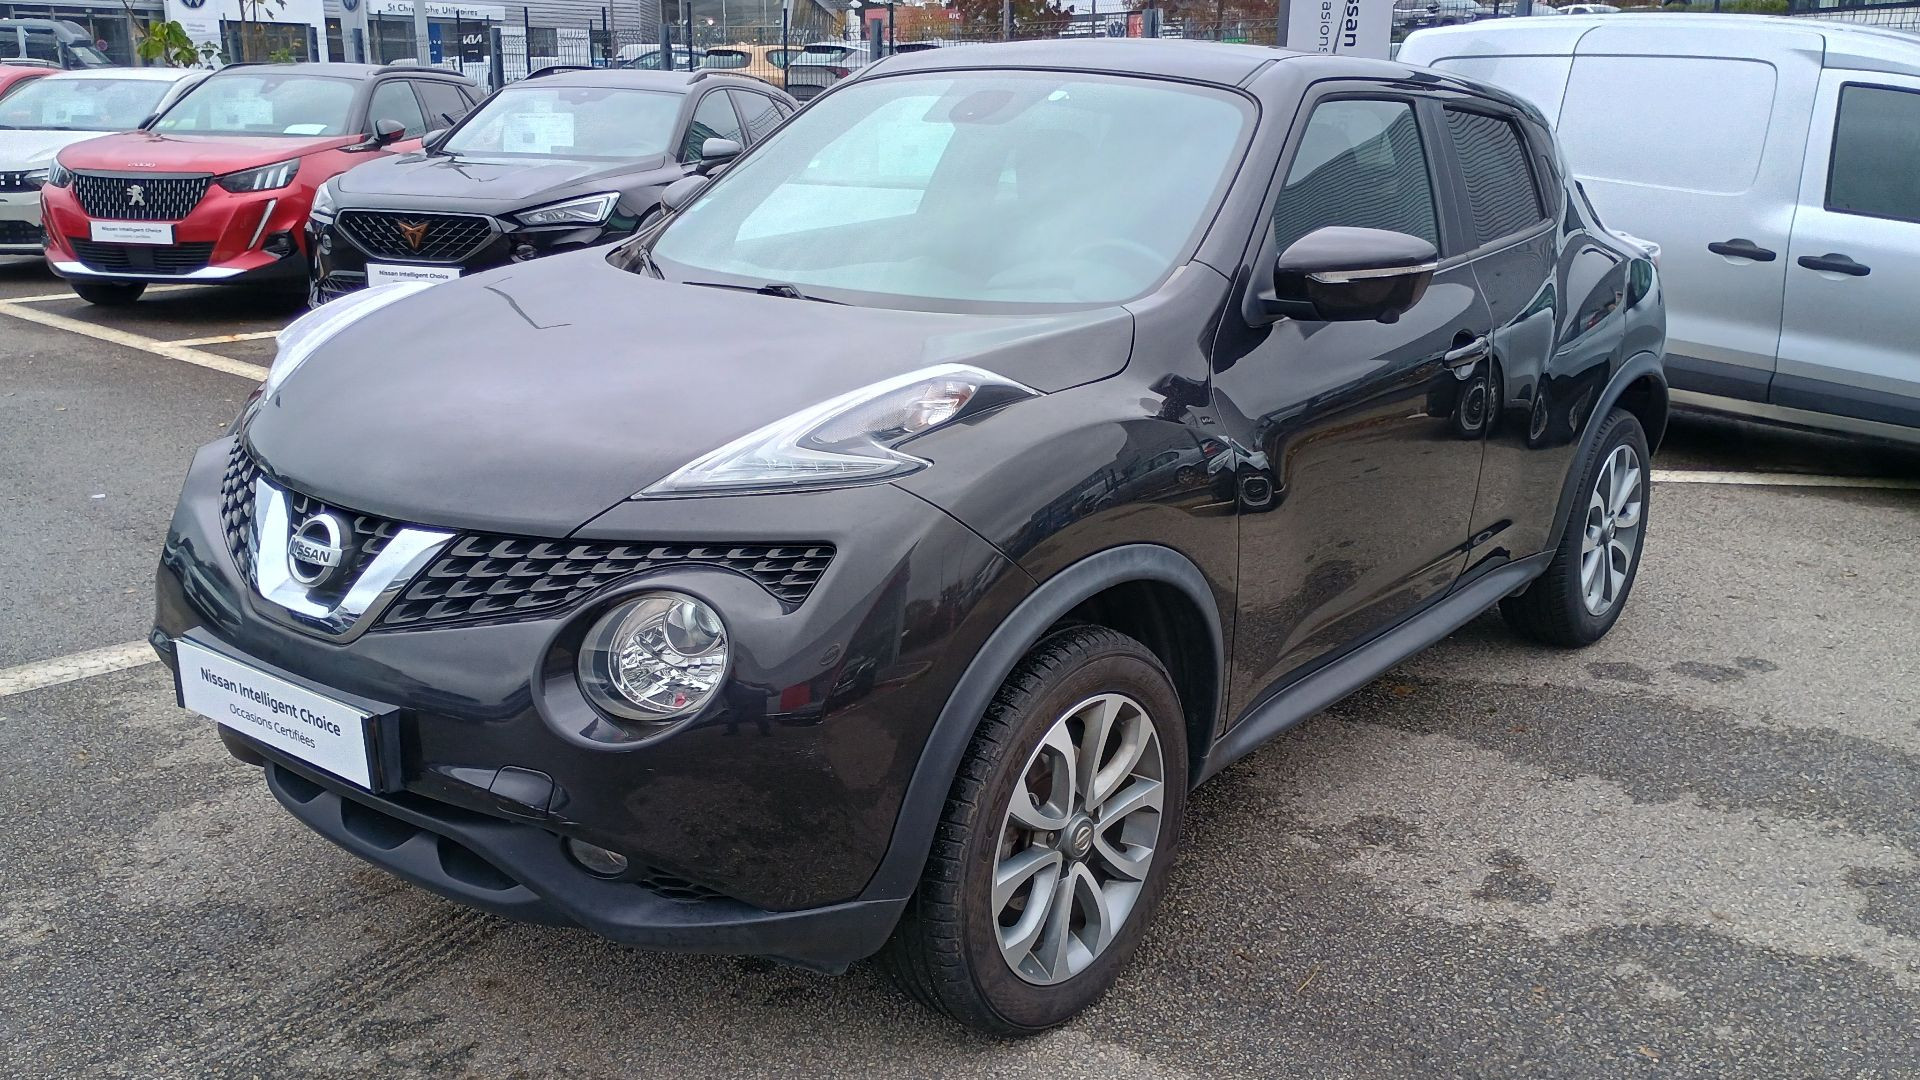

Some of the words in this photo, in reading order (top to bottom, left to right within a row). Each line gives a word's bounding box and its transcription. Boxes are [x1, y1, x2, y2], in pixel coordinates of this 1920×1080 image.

[462, 34, 483, 45] KIA
[399, 271, 428, 279] Intelligent
[200, 667, 242, 694] Nissan
[239, 682, 299, 720] Intelligent
[299, 707, 341, 737] Choice
[229, 703, 273, 730] Occasions
[274, 722, 316, 749] Certifiées
